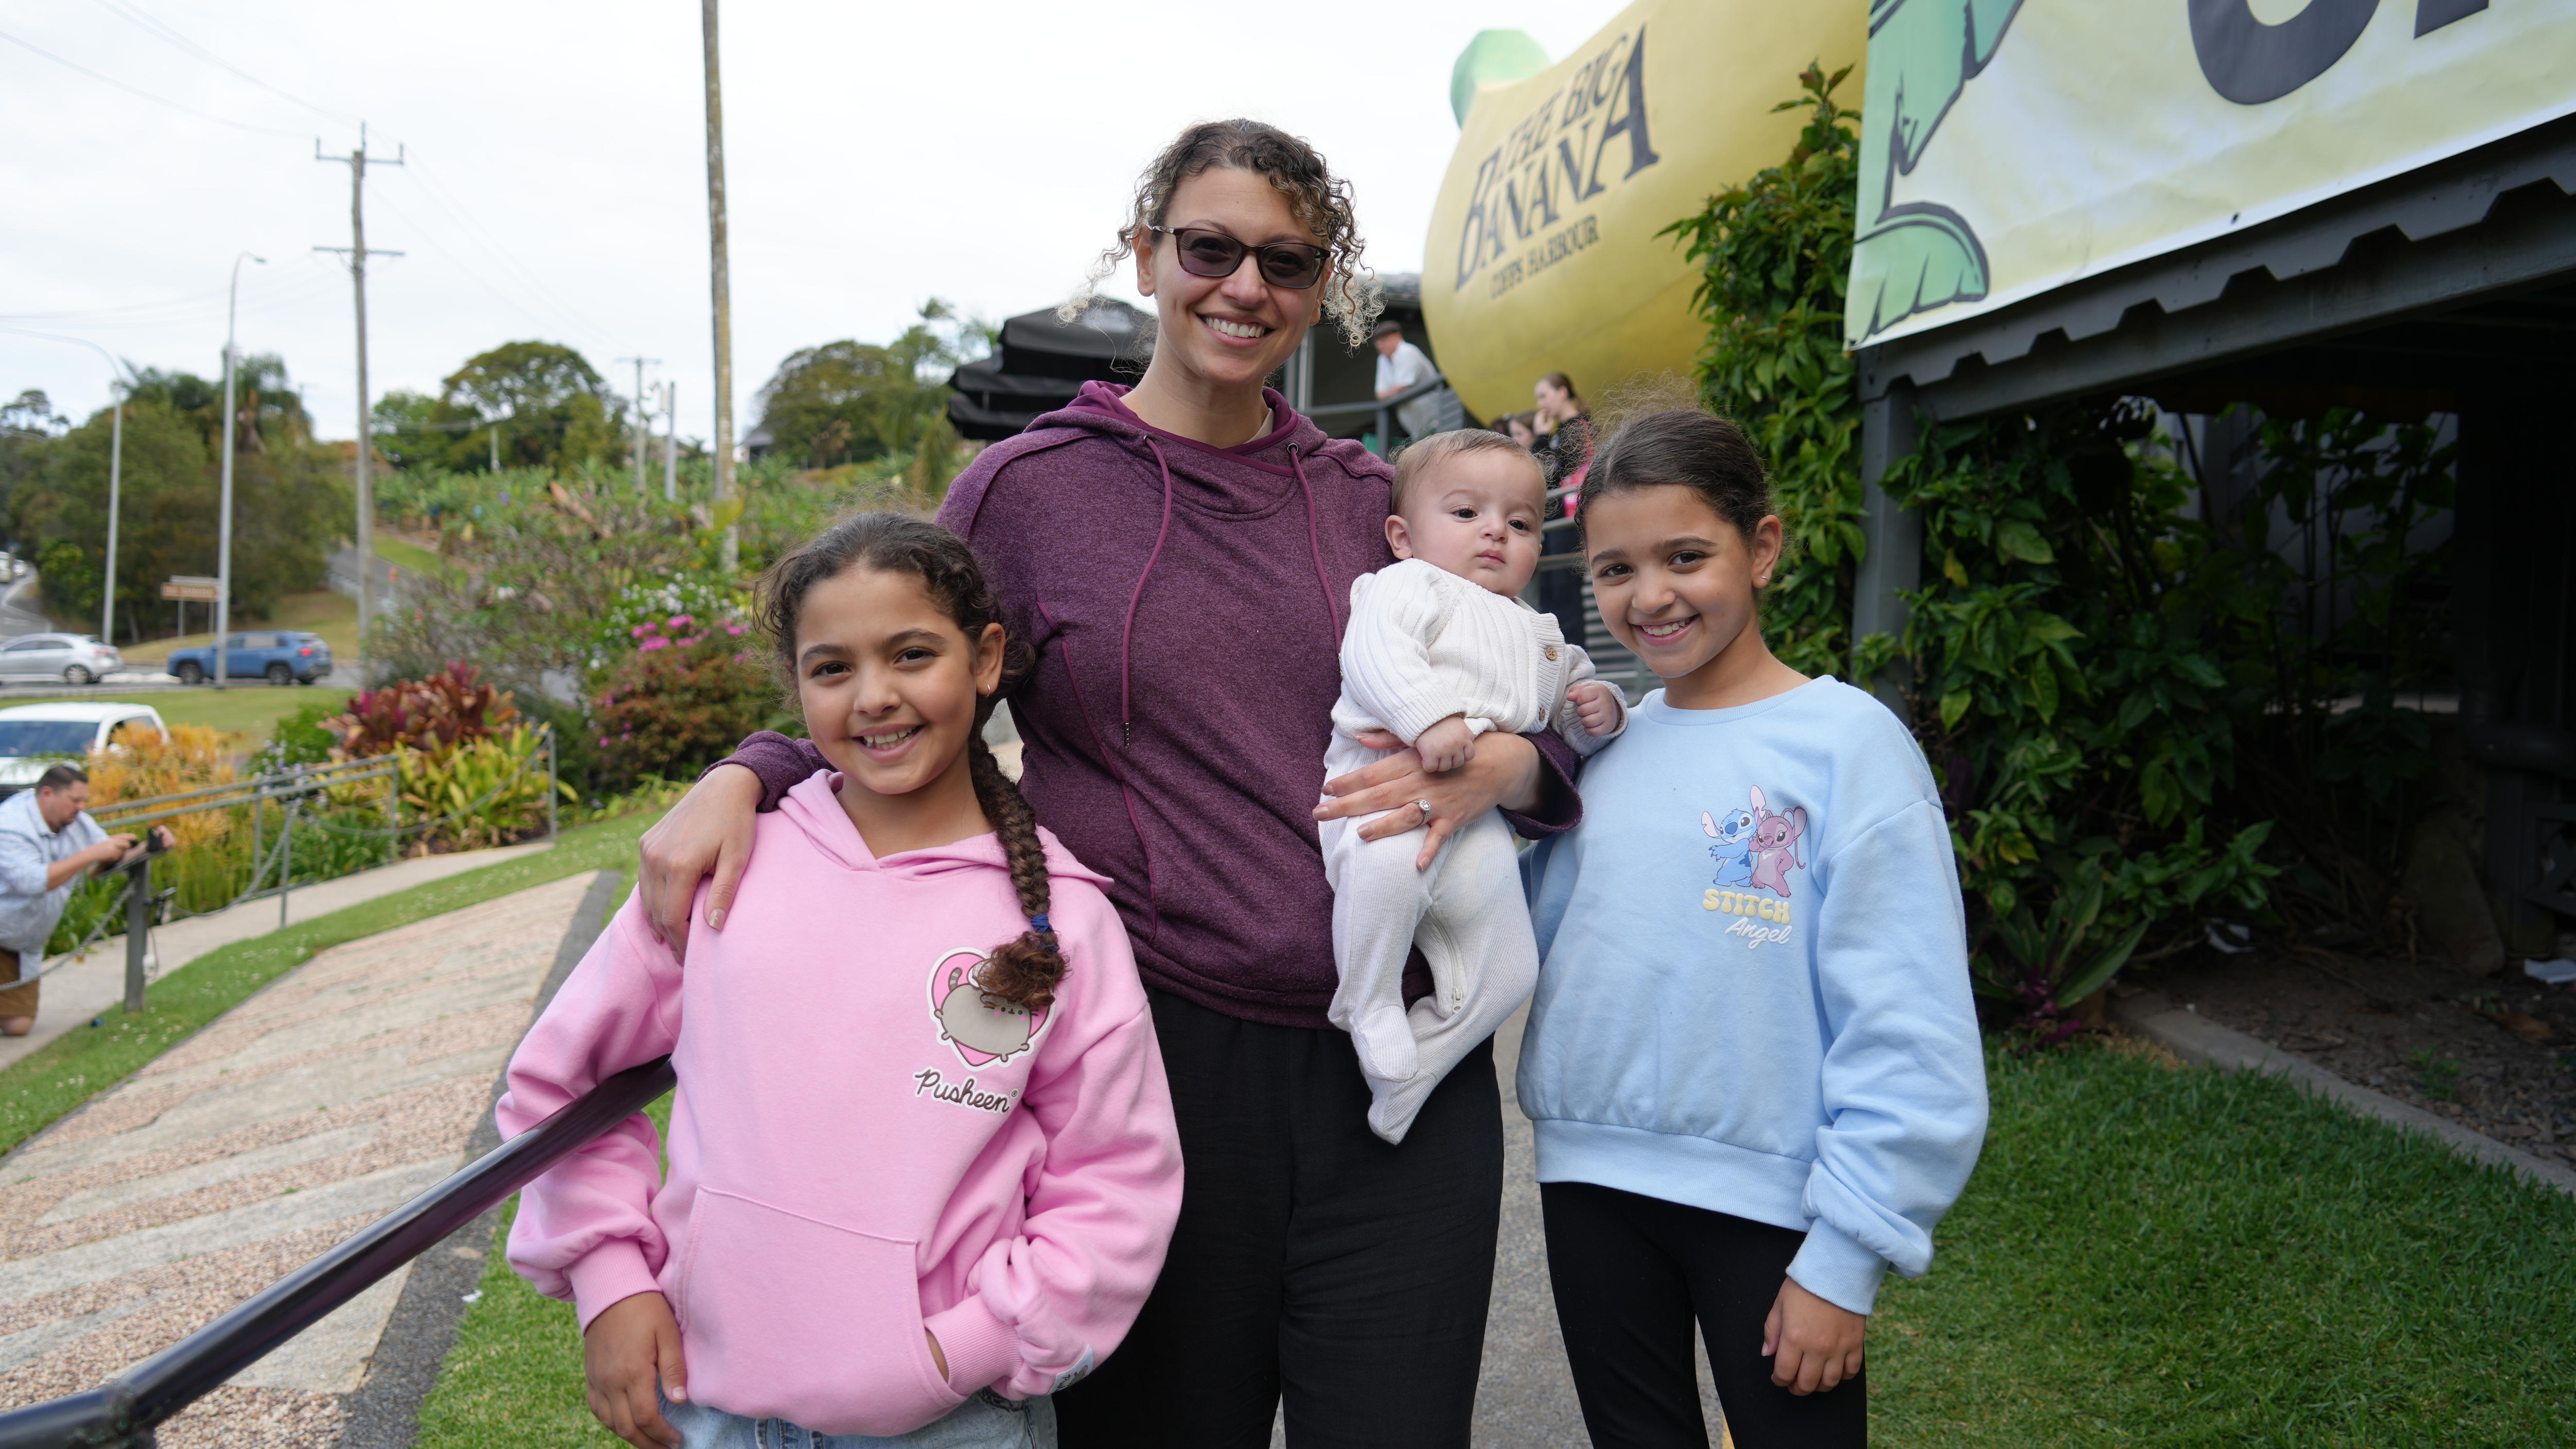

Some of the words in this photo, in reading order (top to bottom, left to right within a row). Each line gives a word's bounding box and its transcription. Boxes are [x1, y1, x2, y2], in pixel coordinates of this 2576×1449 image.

[1496, 87, 1564, 182] THE
[1559, 33, 1629, 132] BIG
[1455, 22, 1660, 291] BANANA
[1527, 214, 1599, 277] HARBOUR
[1702, 889, 1790, 925] STITCH
[1724, 917, 1792, 950] Angel
